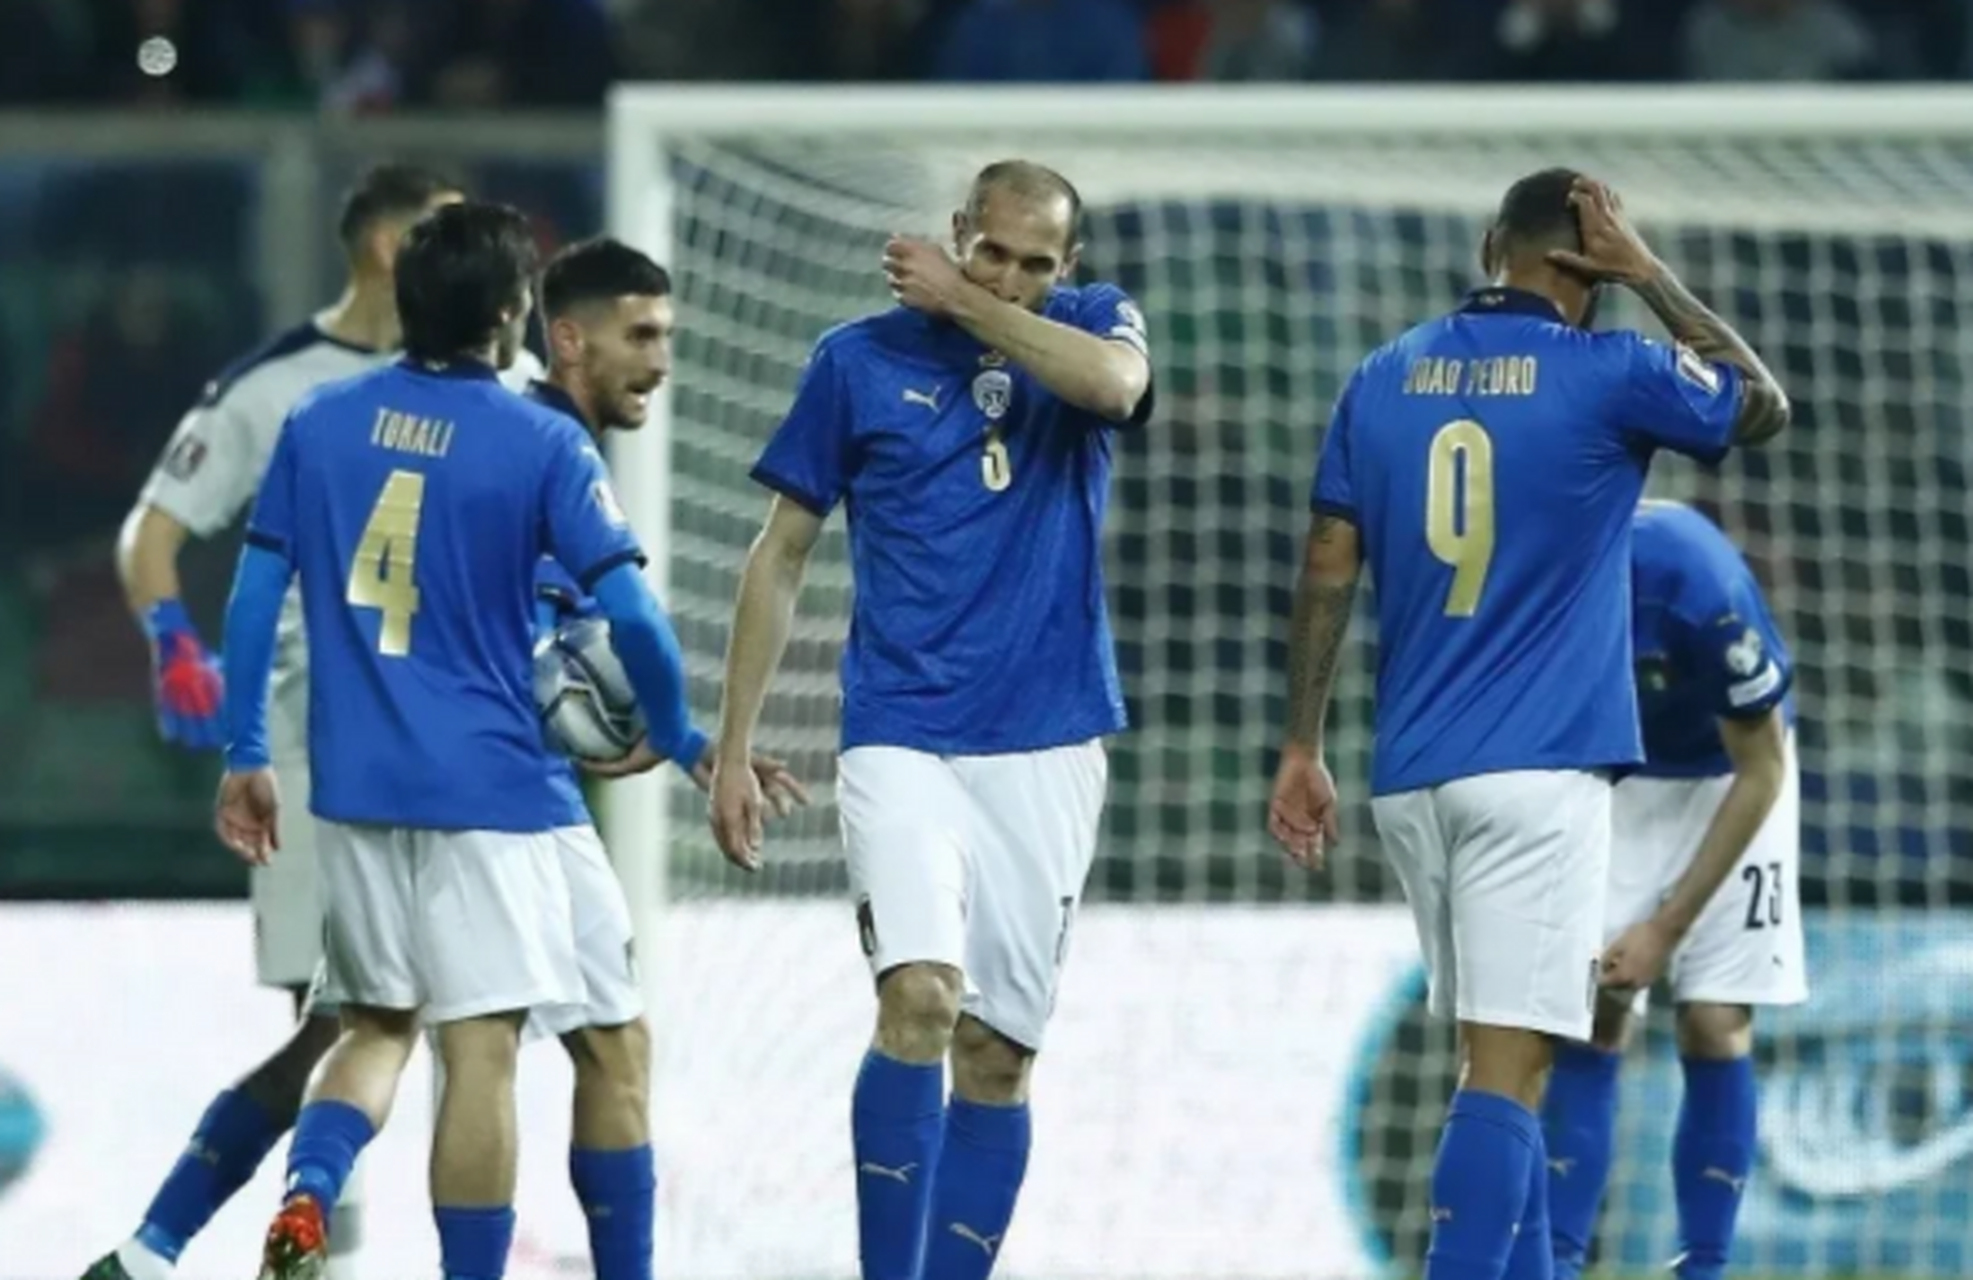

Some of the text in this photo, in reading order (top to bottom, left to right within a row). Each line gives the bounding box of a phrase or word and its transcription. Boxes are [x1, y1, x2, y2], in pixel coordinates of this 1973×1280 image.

[1465, 355, 1536, 395] PEDRO
[371, 406, 455, 457] TONALI
[1426, 418, 1495, 617] 9
[346, 468, 425, 656] 4
[1742, 862, 1782, 929] 23
